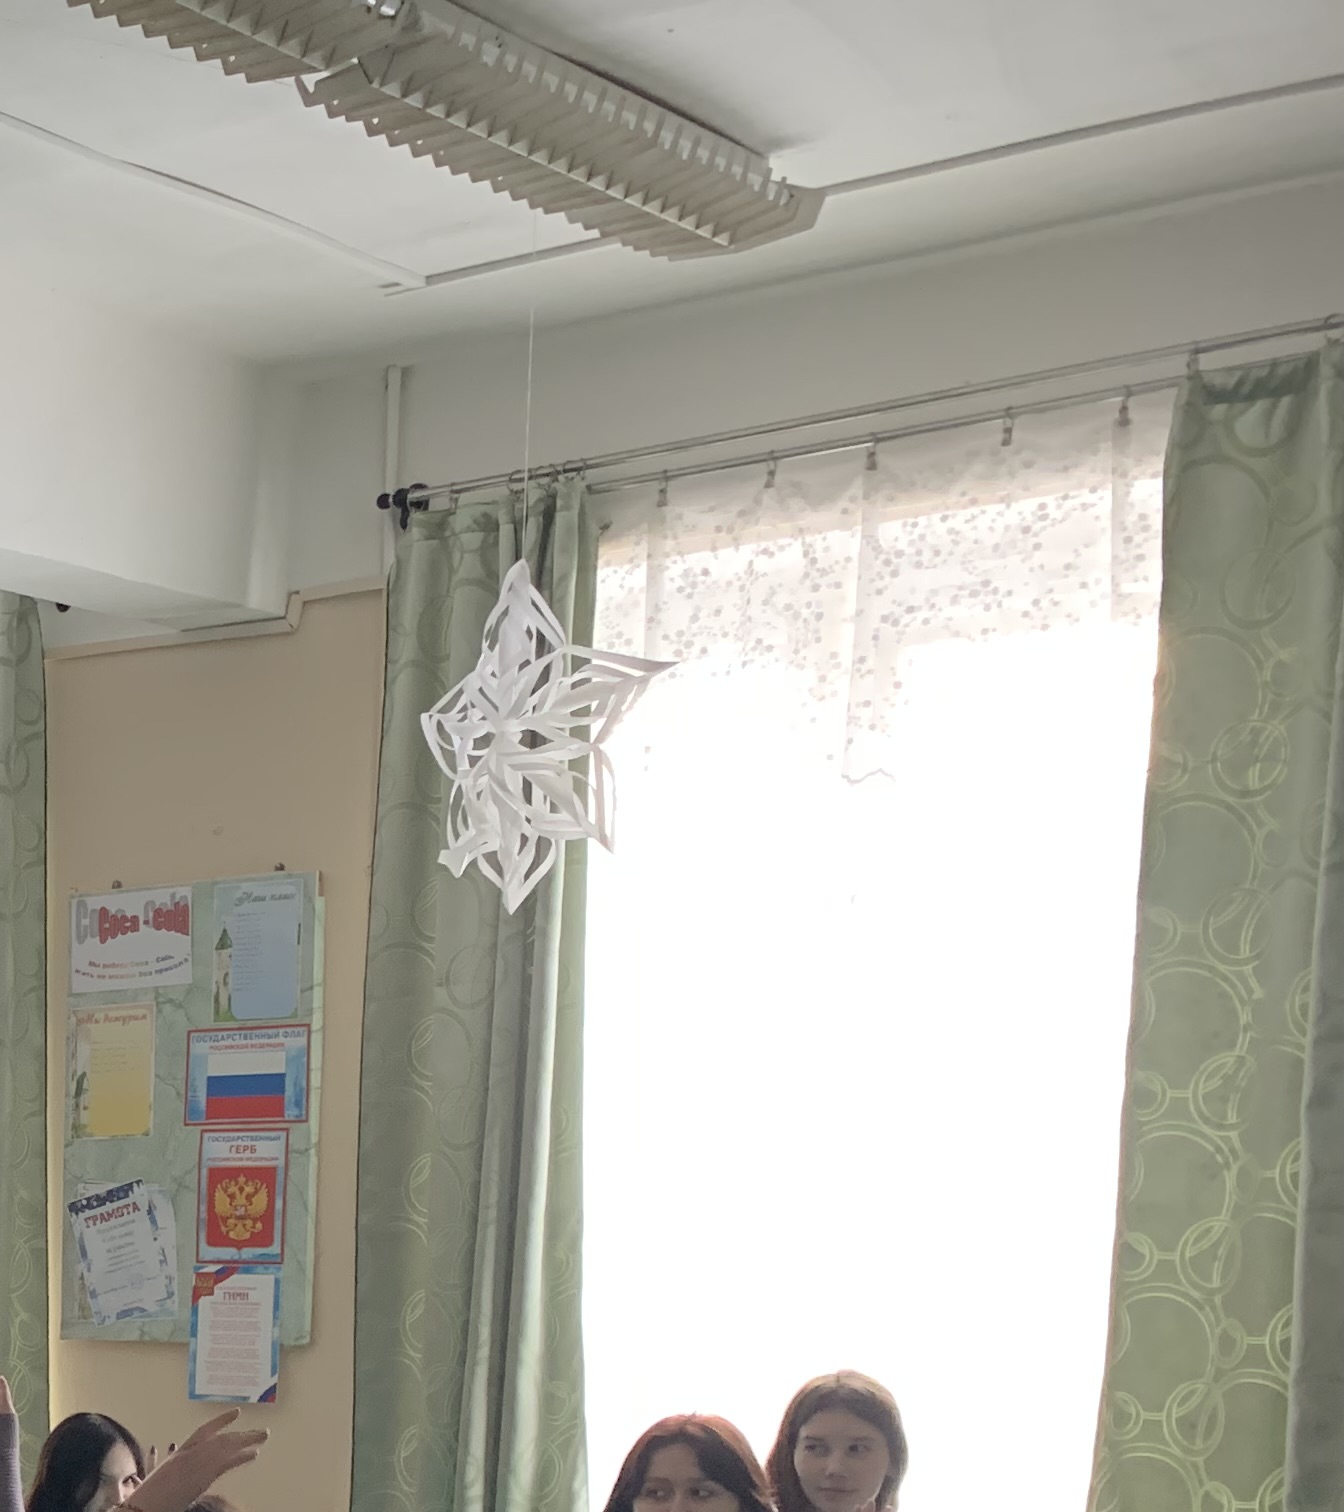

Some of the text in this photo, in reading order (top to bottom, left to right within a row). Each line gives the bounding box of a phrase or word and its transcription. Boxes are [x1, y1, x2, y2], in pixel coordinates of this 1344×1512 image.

[192, 1029, 306, 1044] ГОСУДАРСТВЕННЫЙ ФЛАГ
[207, 1135, 281, 1144] ГОСУДАРСТВЕННЫЙ
[229, 1144, 257, 1154] ГЕРБ
[83, 1201, 141, 1229] ГРАМОТА
